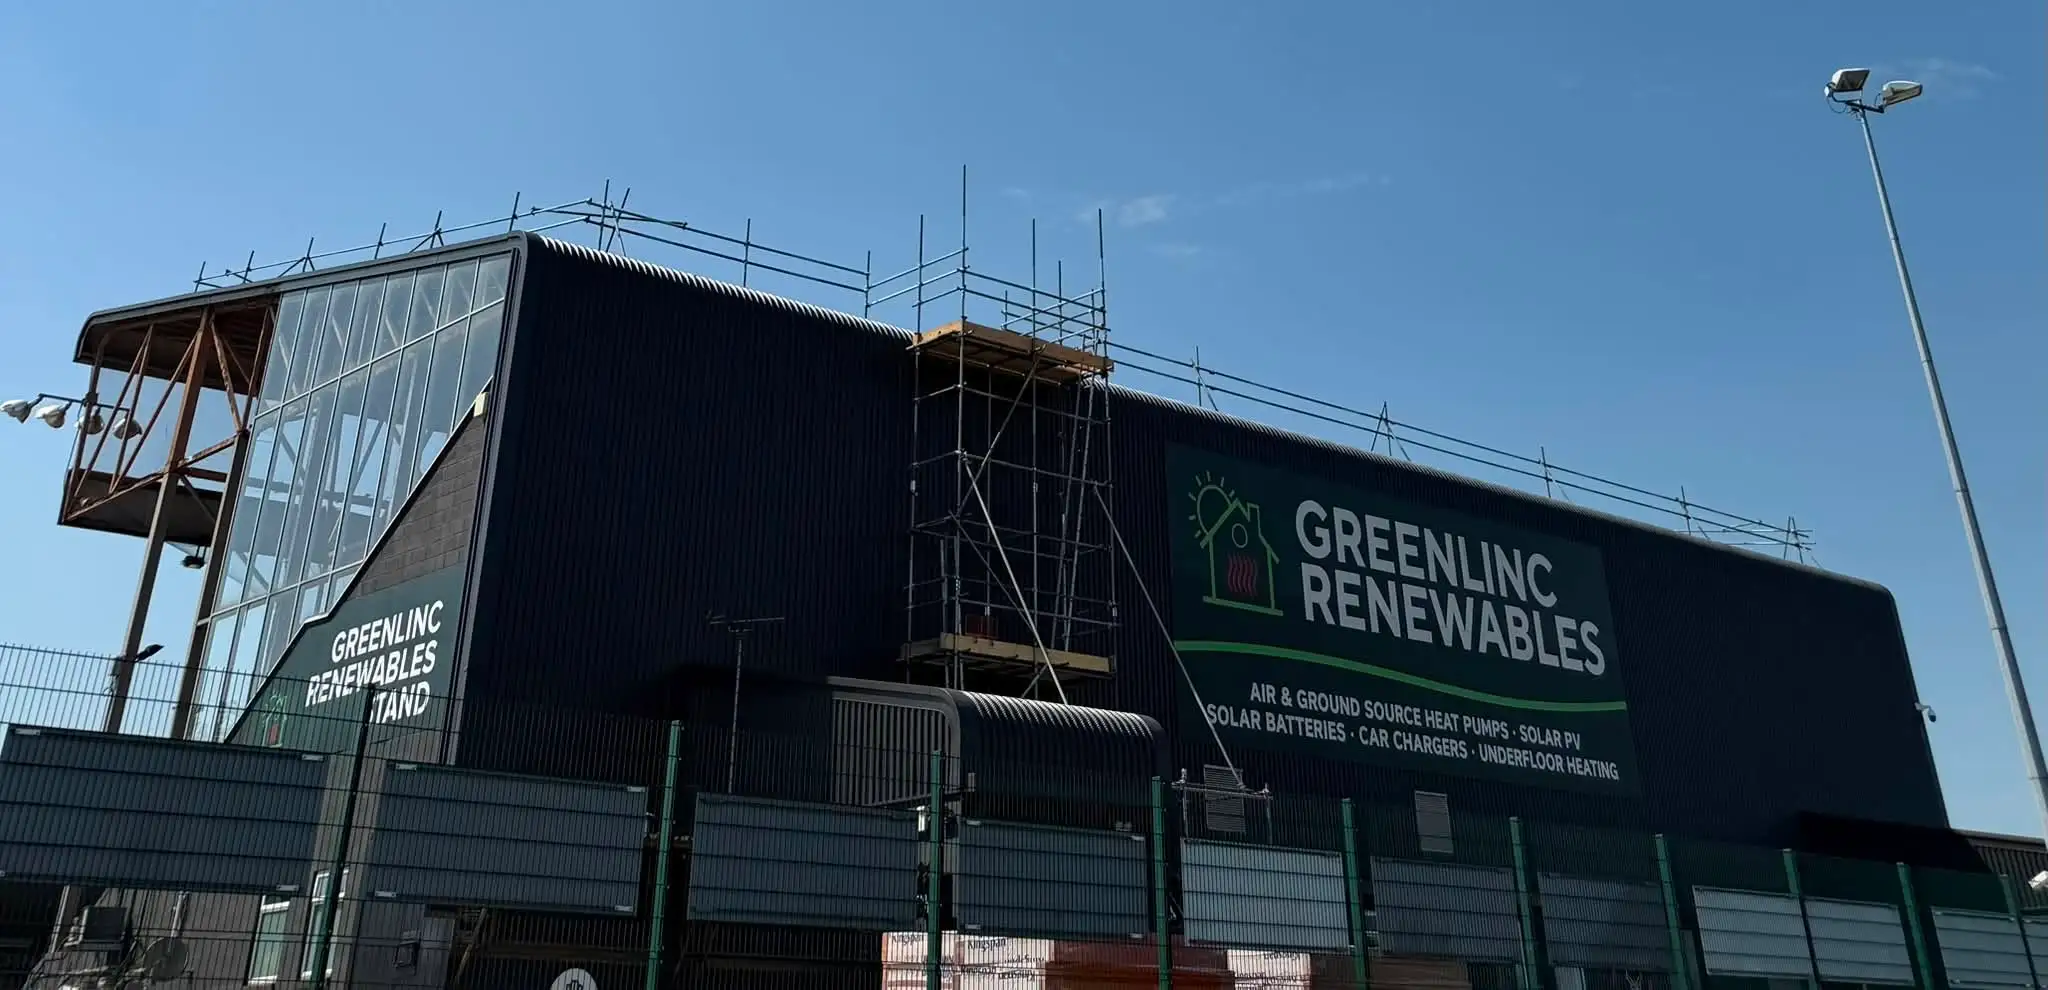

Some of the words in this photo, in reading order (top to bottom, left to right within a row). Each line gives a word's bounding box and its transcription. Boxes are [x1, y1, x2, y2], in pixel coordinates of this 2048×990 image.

[1295, 500, 1558, 608] GREENLINC
[331, 600, 444, 663] GREENLINC
[1301, 562, 1605, 676] RENEWABLES
[305, 639, 438, 708] RENEWABLES
[1206, 703, 1262, 730] SOLAR
[1265, 711, 1346, 742] BATTERIES
[1359, 725, 1390, 748] CAR
[1393, 730, 1468, 759] CHARGERS
[1478, 743, 1565, 773] UNDERFLOOR
[1566, 756, 1619, 780] HEATING
[1250, 682, 1277, 704] AIR
[1281, 686, 1293, 707] &
[1296, 689, 1361, 717] GROUND
[1364, 700, 1422, 727] SOURCE
[1424, 709, 1459, 732] HEAT
[1462, 715, 1509, 740] PUMPS
[1519, 724, 1562, 748] SOLAR
[1563, 731, 1581, 751] PV
